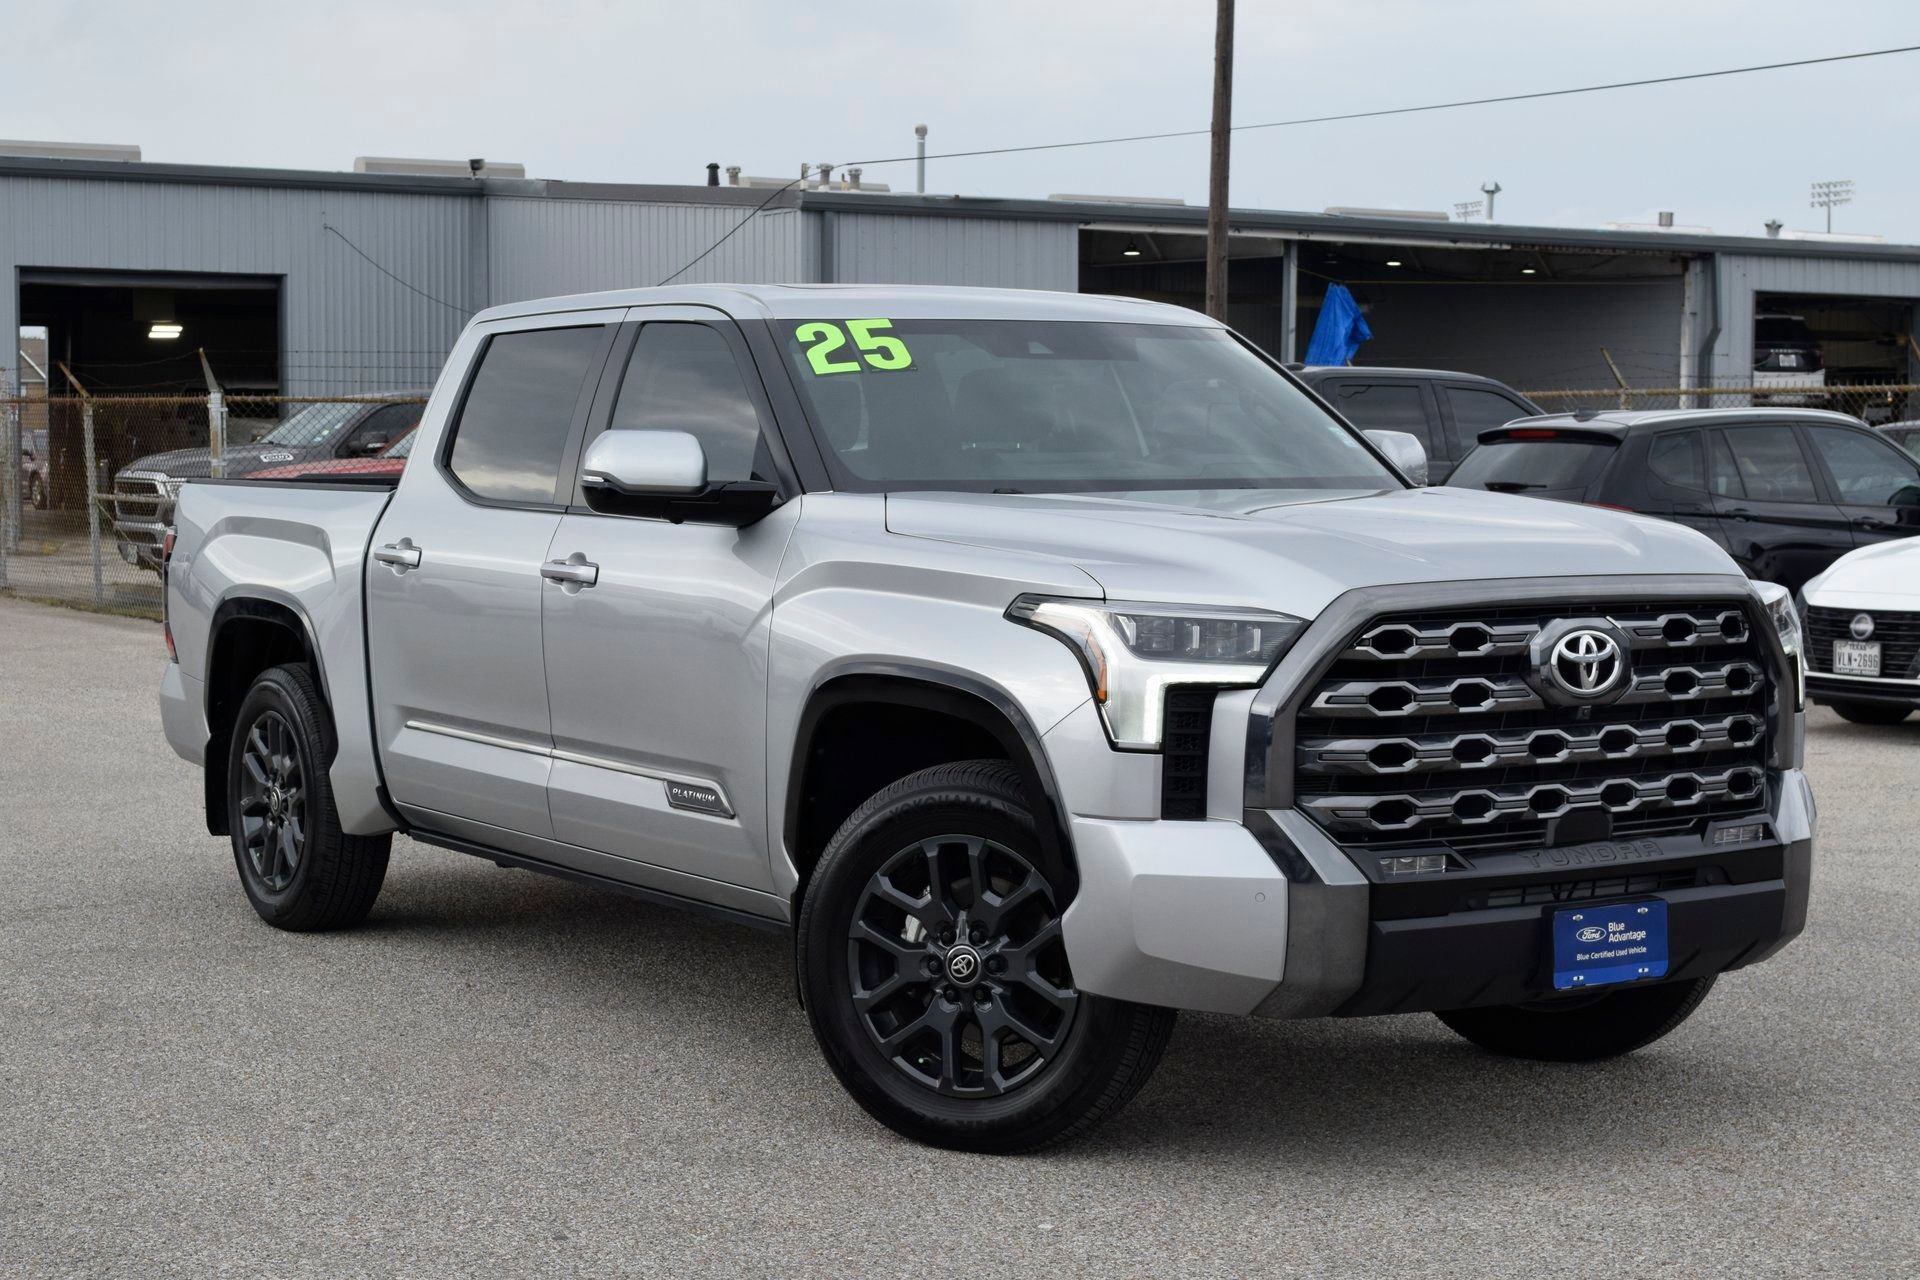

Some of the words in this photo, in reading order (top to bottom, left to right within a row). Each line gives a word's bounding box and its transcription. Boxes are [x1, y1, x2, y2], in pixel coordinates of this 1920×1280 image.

[795, 318, 913, 375] 25
[672, 788, 716, 802] PLATINUM
[1517, 840, 1664, 868] TUNDRA
[1581, 929, 1601, 940] Ford
[1608, 922, 1625, 932] Blue
[1608, 930, 1647, 943] Advantage
[1576, 953, 1590, 961] Blue
[1590, 950, 1615, 960] Certified
[1615, 948, 1628, 957] Used
[1628, 946, 1647, 955] Vehicle
